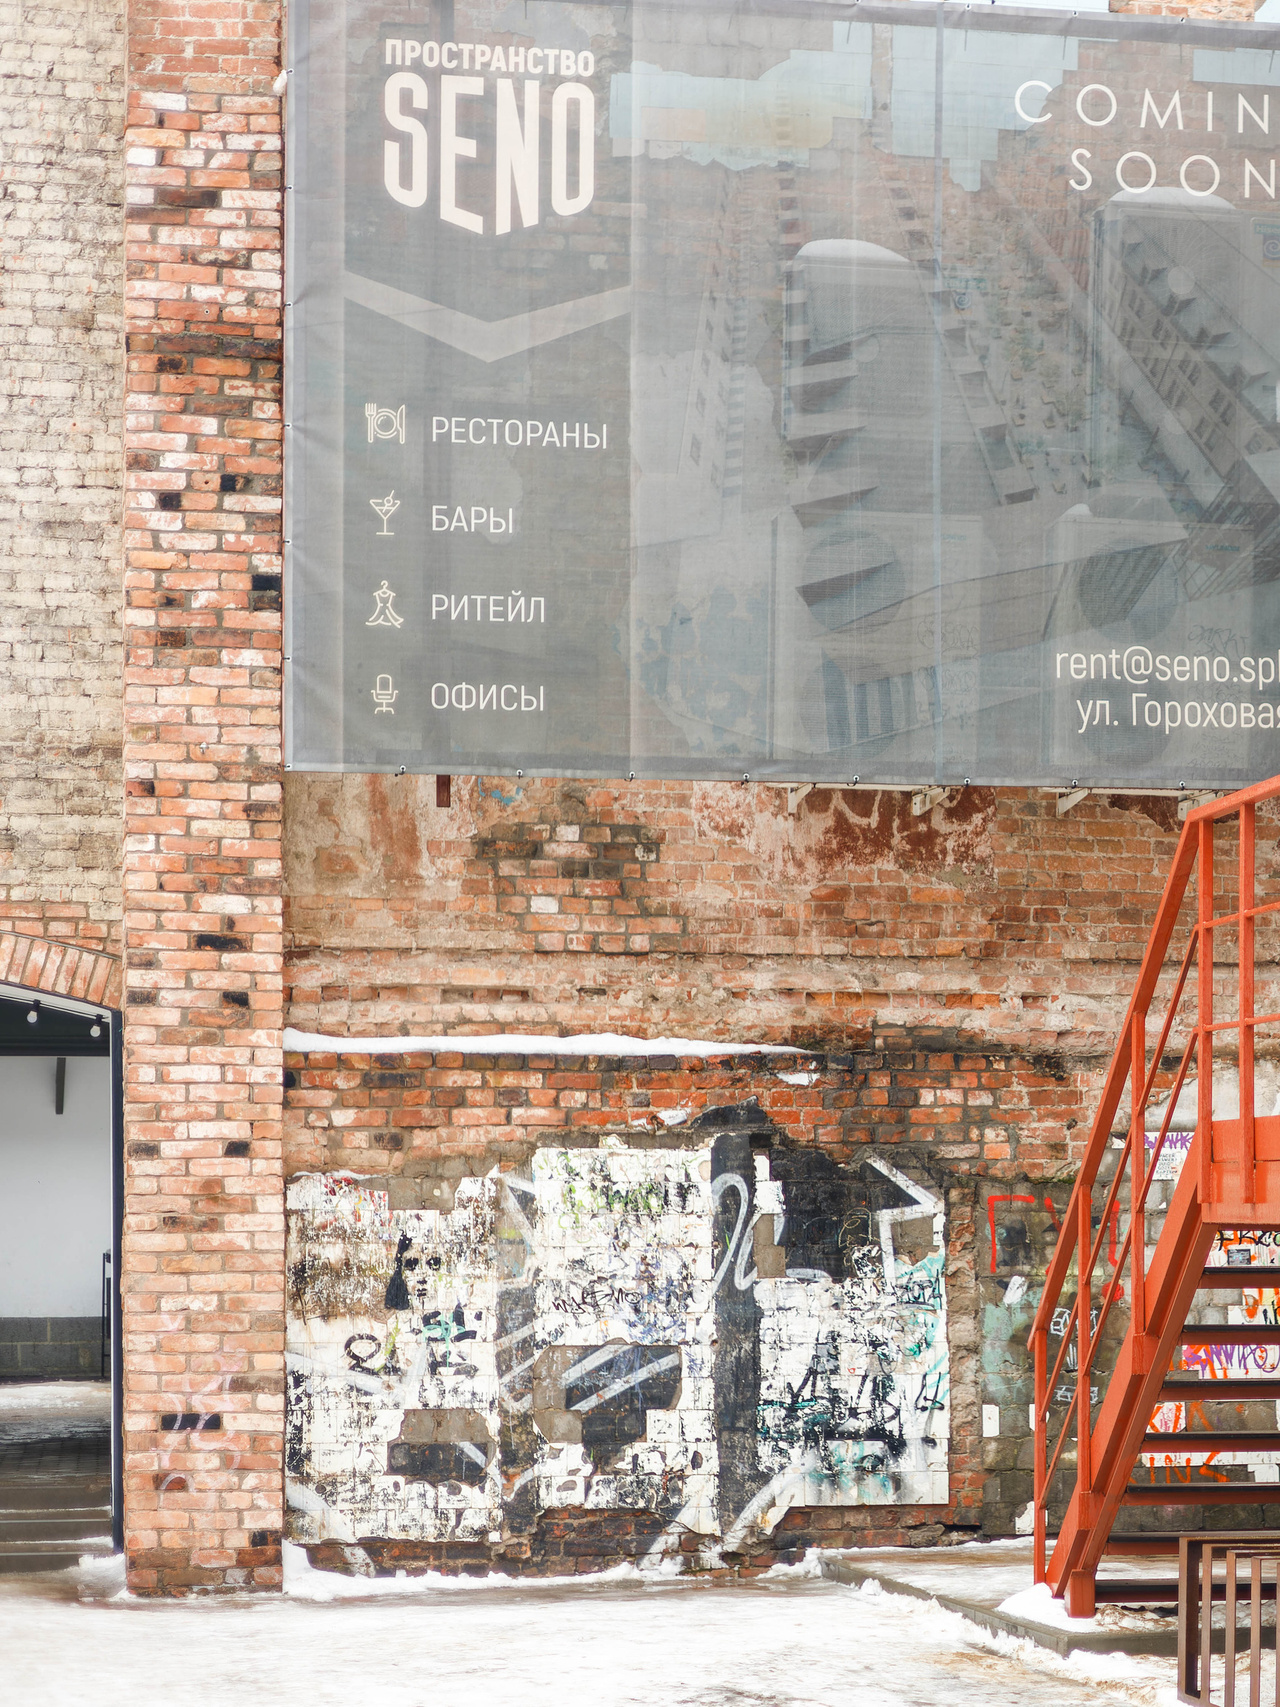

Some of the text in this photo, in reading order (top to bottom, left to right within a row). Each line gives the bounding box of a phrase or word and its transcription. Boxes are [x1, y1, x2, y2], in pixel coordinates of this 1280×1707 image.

[384, 38, 595, 77] ПРОСТРАНСТВО
[384, 71, 595, 236] SENO
[1068, 147, 1277, 199] SOON
[430, 416, 608, 449] РЕСТОРАНЫ
[430, 505, 514, 534] БАРЫ
[430, 589, 546, 624] РИТЕЙЛ
[430, 682, 546, 712] ОФИСЫ
[1076, 698, 1119, 734] ул.
